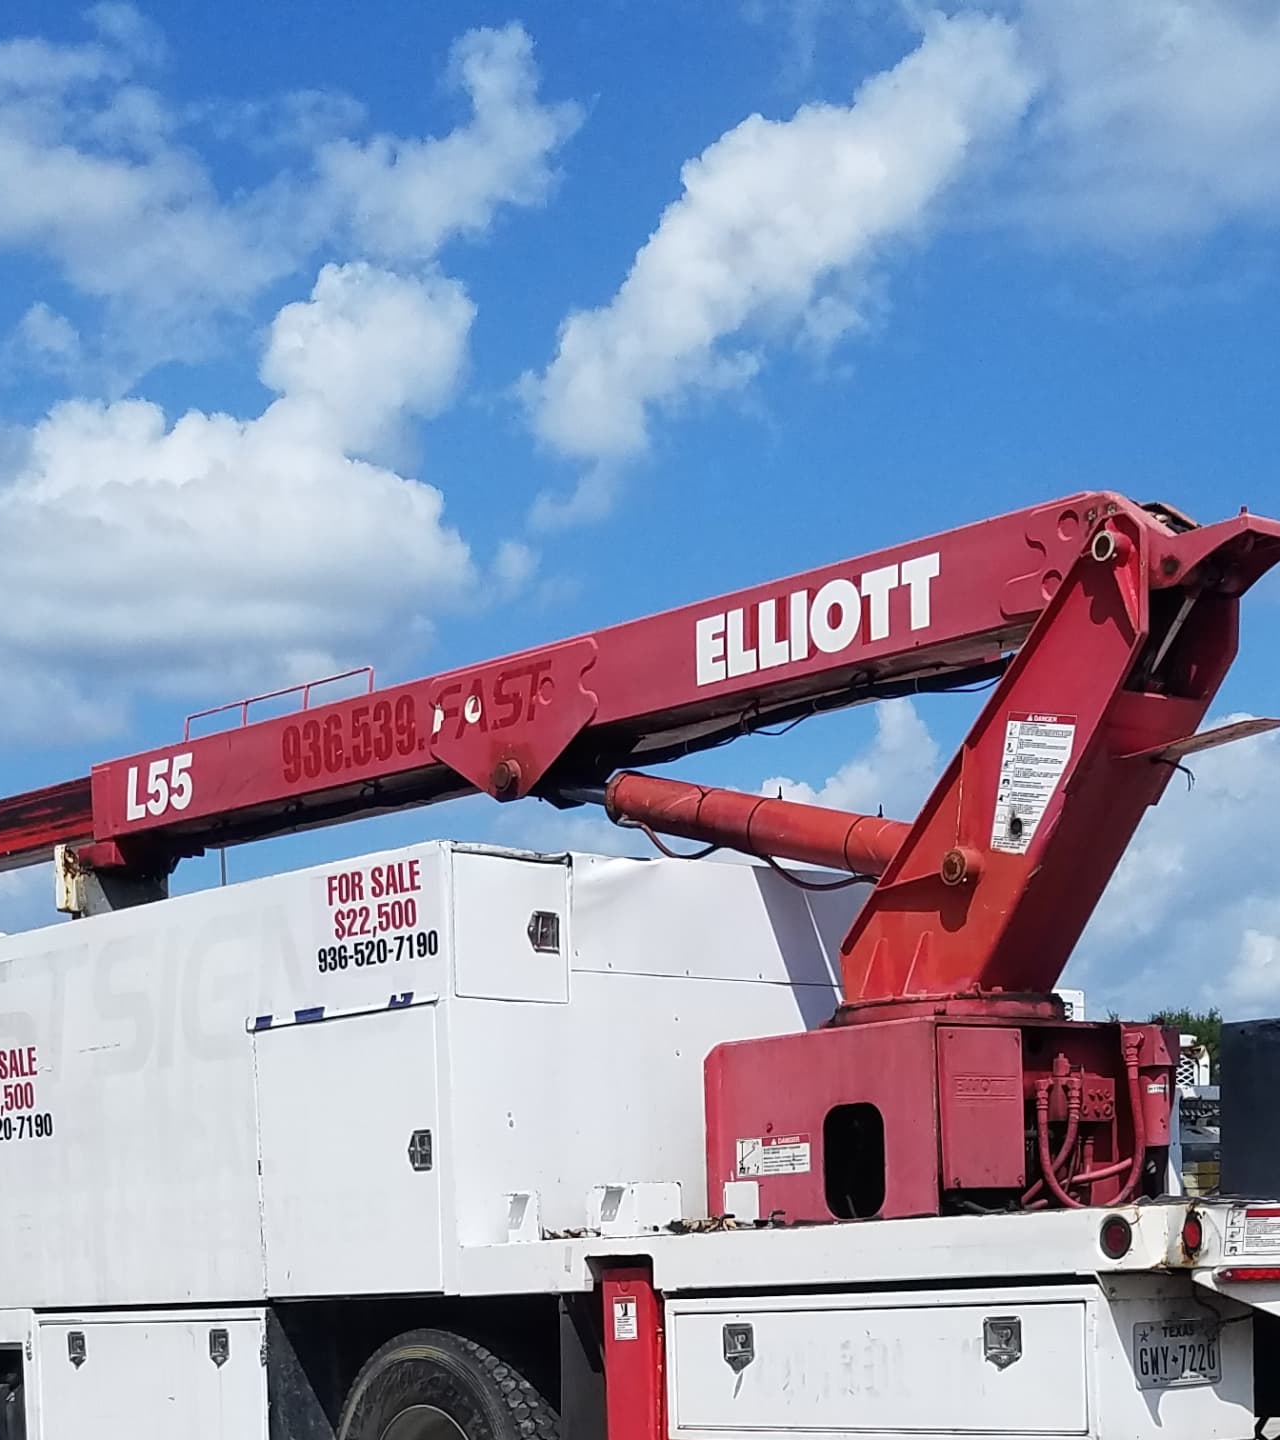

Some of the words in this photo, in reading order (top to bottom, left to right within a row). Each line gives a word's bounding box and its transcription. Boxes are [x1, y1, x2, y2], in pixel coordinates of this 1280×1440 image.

[695, 551, 940, 687] ELLIOTT
[126, 752, 194, 822] L55
[327, 870, 364, 906] FOR
[370, 859, 421, 898] SALE
[334, 898, 417, 941] $22,500
[318, 930, 439, 973] 936-520-7190
[1161, 1324, 1195, 1338] TEXAS
